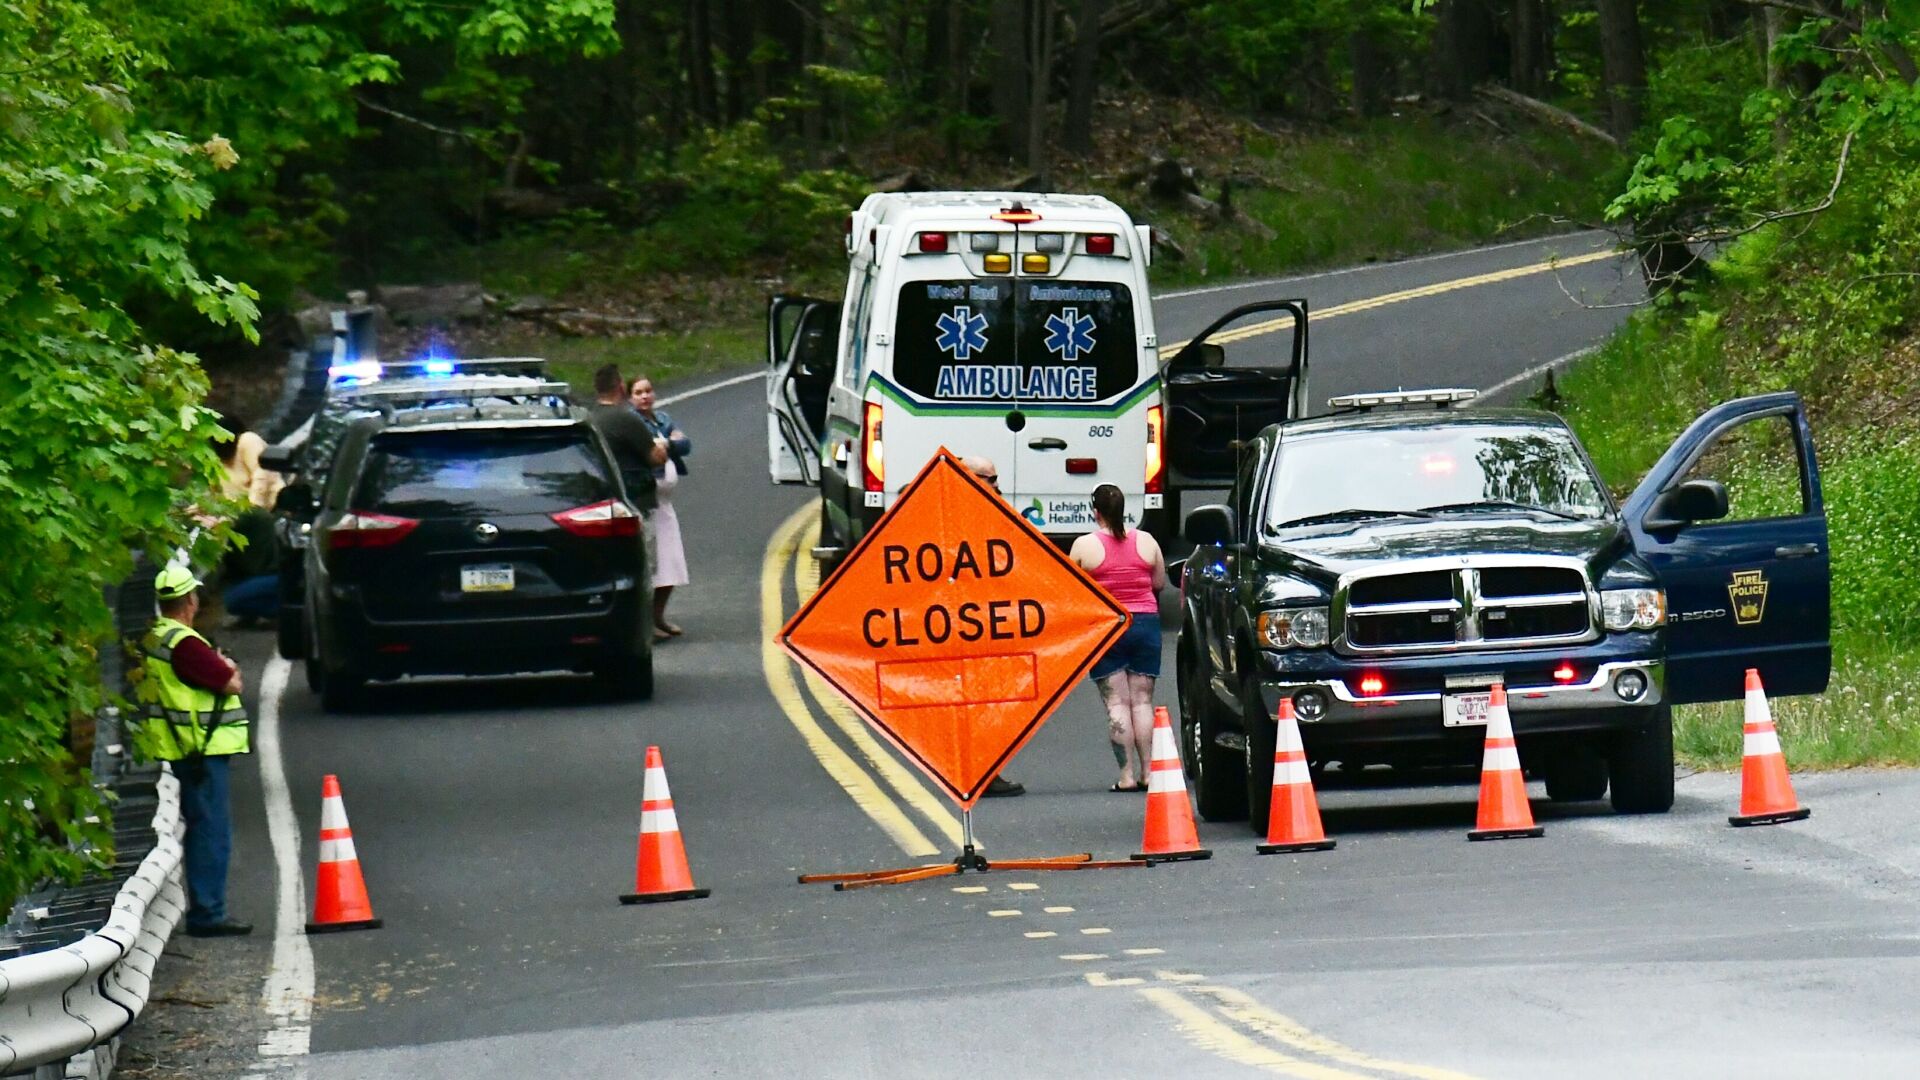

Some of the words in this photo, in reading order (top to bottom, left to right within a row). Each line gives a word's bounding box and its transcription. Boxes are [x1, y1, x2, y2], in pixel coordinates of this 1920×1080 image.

[935, 365, 1097, 399] AMBULANCE
[1088, 425, 1114, 438] 805
[1049, 501, 1087, 513] Lehigh
[1049, 513, 1086, 524] Health
[884, 539, 1014, 584] ROAD
[1736, 575, 1758, 585] FIRE
[1732, 585, 1764, 597] POLICE
[1682, 608, 1727, 621] 2500
[863, 599, 1046, 648] CLOSED
